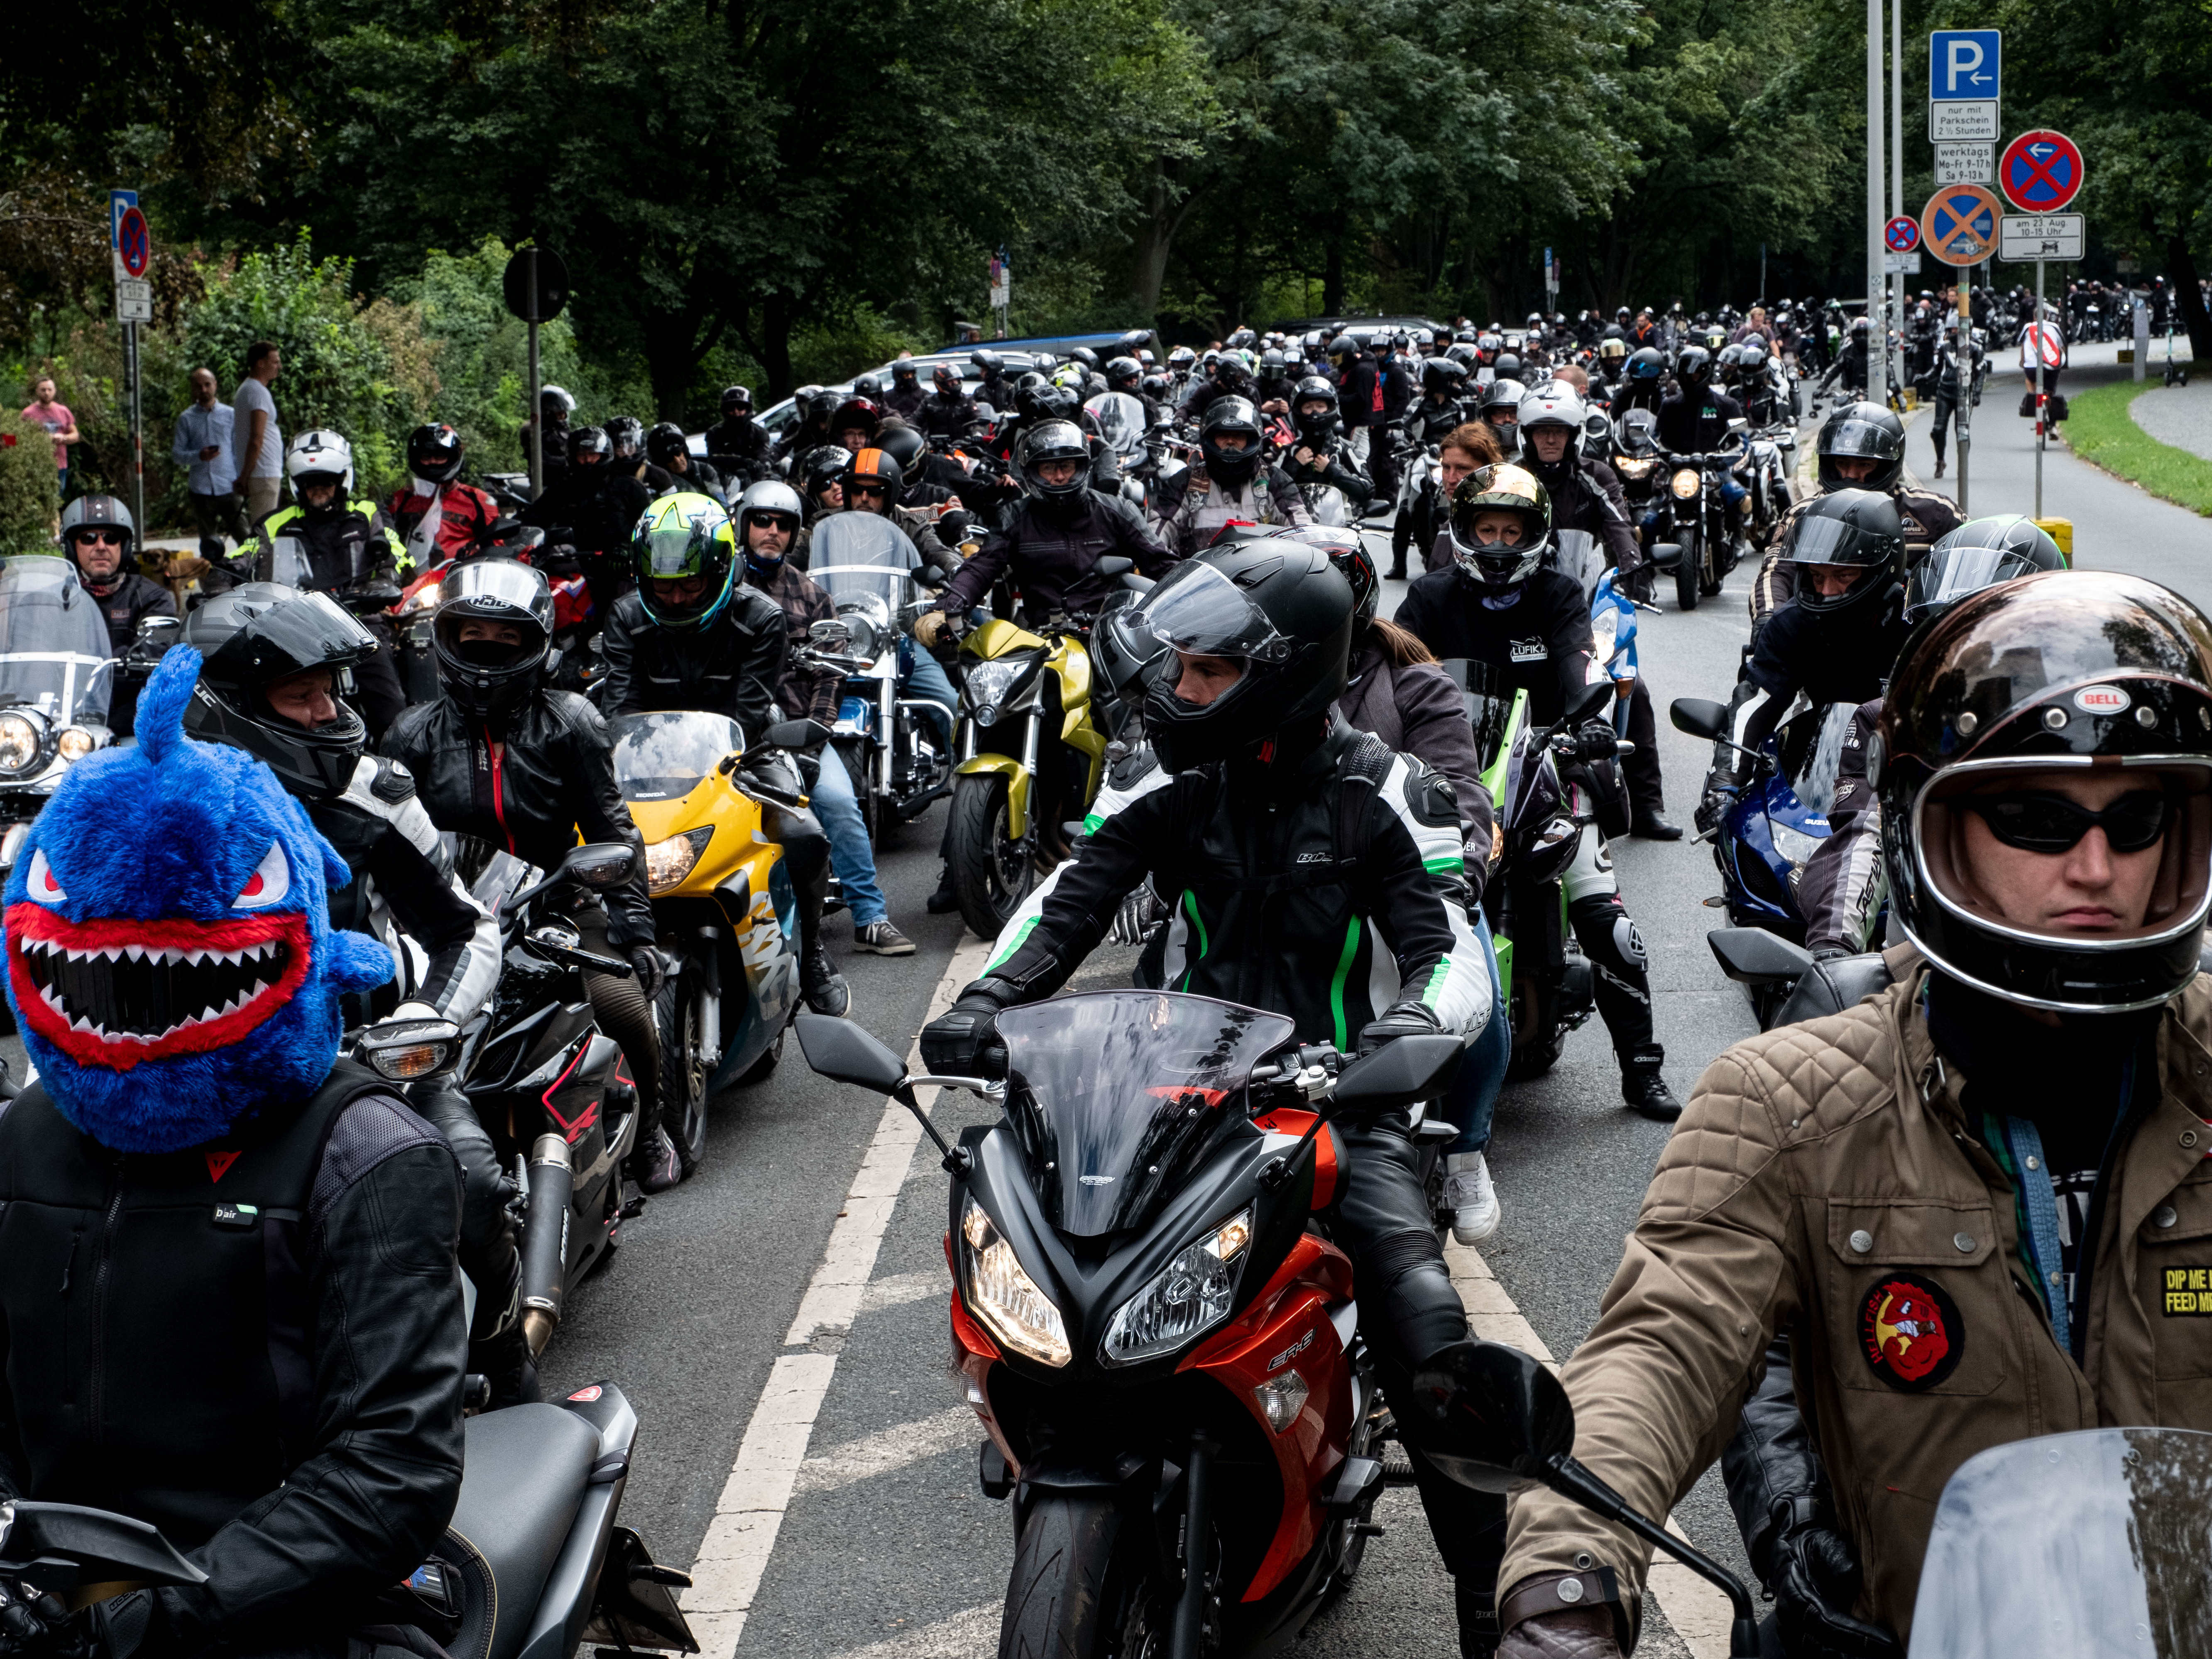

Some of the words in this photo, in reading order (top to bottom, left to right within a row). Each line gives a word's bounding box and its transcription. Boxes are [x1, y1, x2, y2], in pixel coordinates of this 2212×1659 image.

[1947, 40, 1984, 91] P
[1941, 147, 1989, 158] werktags
[1939, 159, 1963, 169] Mo-Fr
[1967, 159, 1984, 168] 9-17
[1986, 159, 1990, 168] h
[1945, 171, 1955, 180] Sa
[1959, 170, 1977, 179] 9-13
[472, 598, 509, 607] HJC
[1512, 644, 1546, 655] LUFIKA
[193, 684, 216, 707] JC
[2085, 695, 2121, 705] BELL
[2166, 1270, 2187, 1290] DIP
[2188, 1270, 2207, 1290] ME
[2166, 1292, 2197, 1312] FEED
[1864, 1290, 1884, 1364] HELLFISH
[1177, 1514, 1186, 1558] ABS
